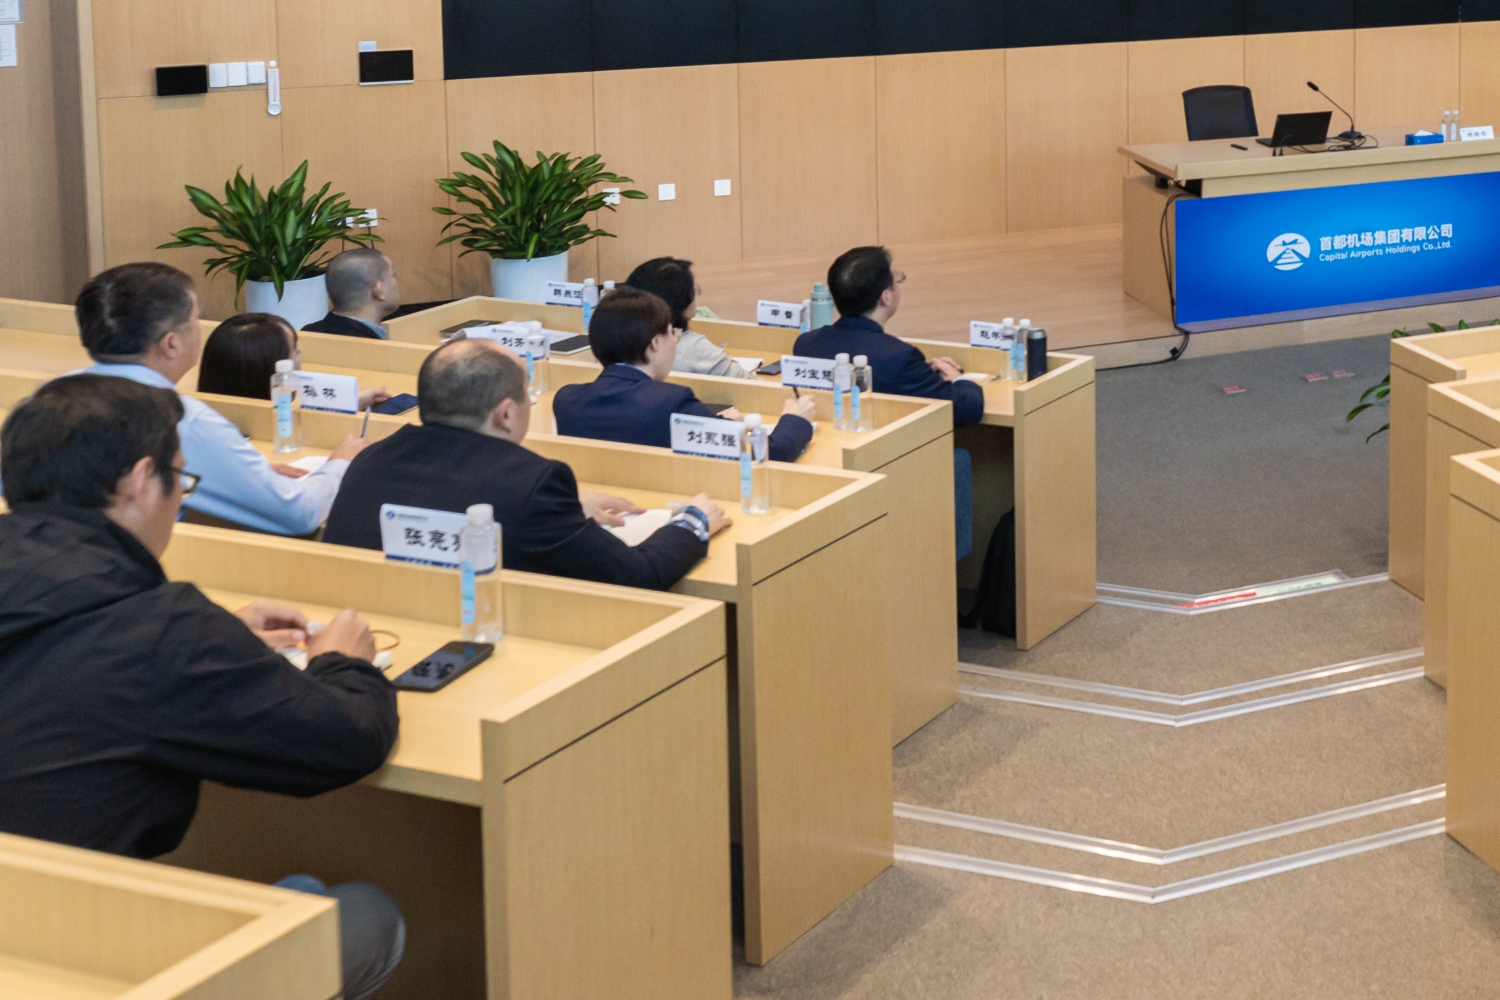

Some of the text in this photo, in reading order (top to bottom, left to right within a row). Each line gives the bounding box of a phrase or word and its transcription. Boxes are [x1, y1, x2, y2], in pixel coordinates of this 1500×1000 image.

[1319, 224, 1453, 251] 首都机场集团有限公司
[1319, 252, 1348, 262] Capital
[1350, 248, 1383, 259] Airports
[1386, 245, 1420, 255] Holdings
